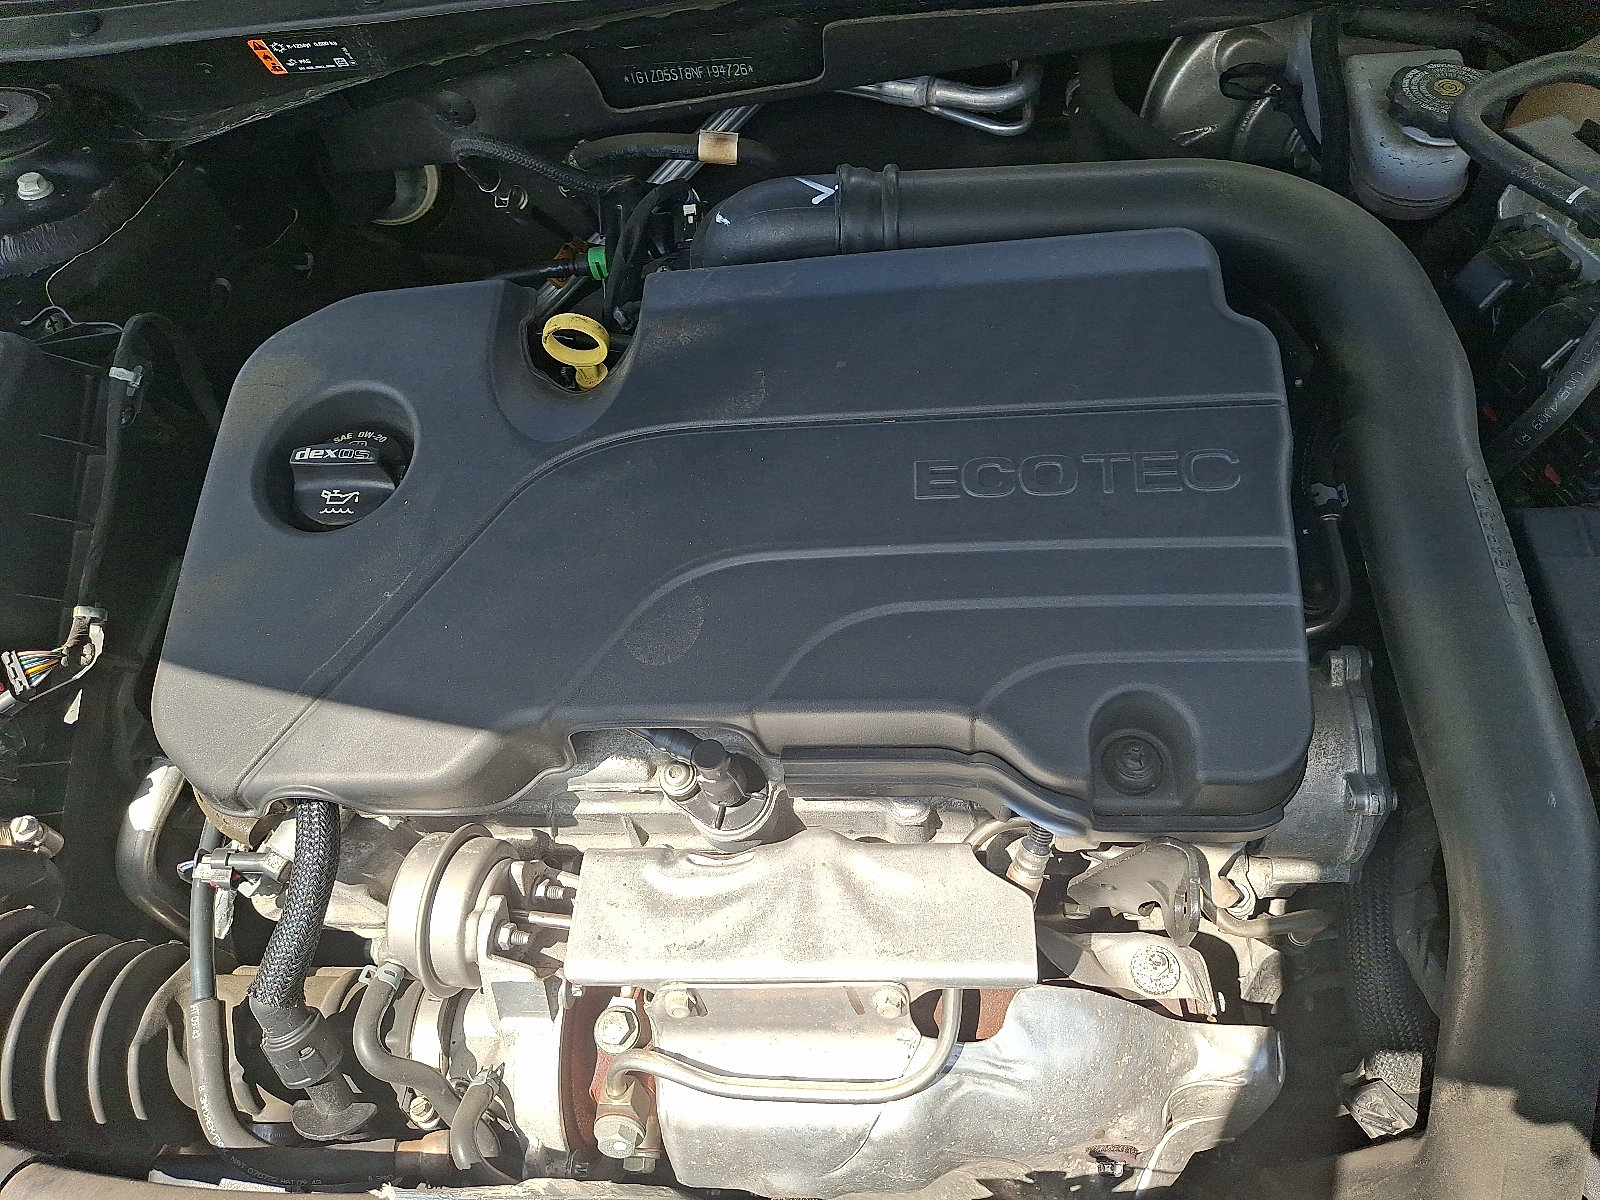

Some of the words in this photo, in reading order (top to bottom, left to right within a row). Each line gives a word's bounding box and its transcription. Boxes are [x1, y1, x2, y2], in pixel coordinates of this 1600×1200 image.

[333, 432, 354, 444] SAE
[357, 430, 388, 443] 0W-20
[294, 447, 371, 461] dexos
[913, 448, 1241, 500] ECOTEC
